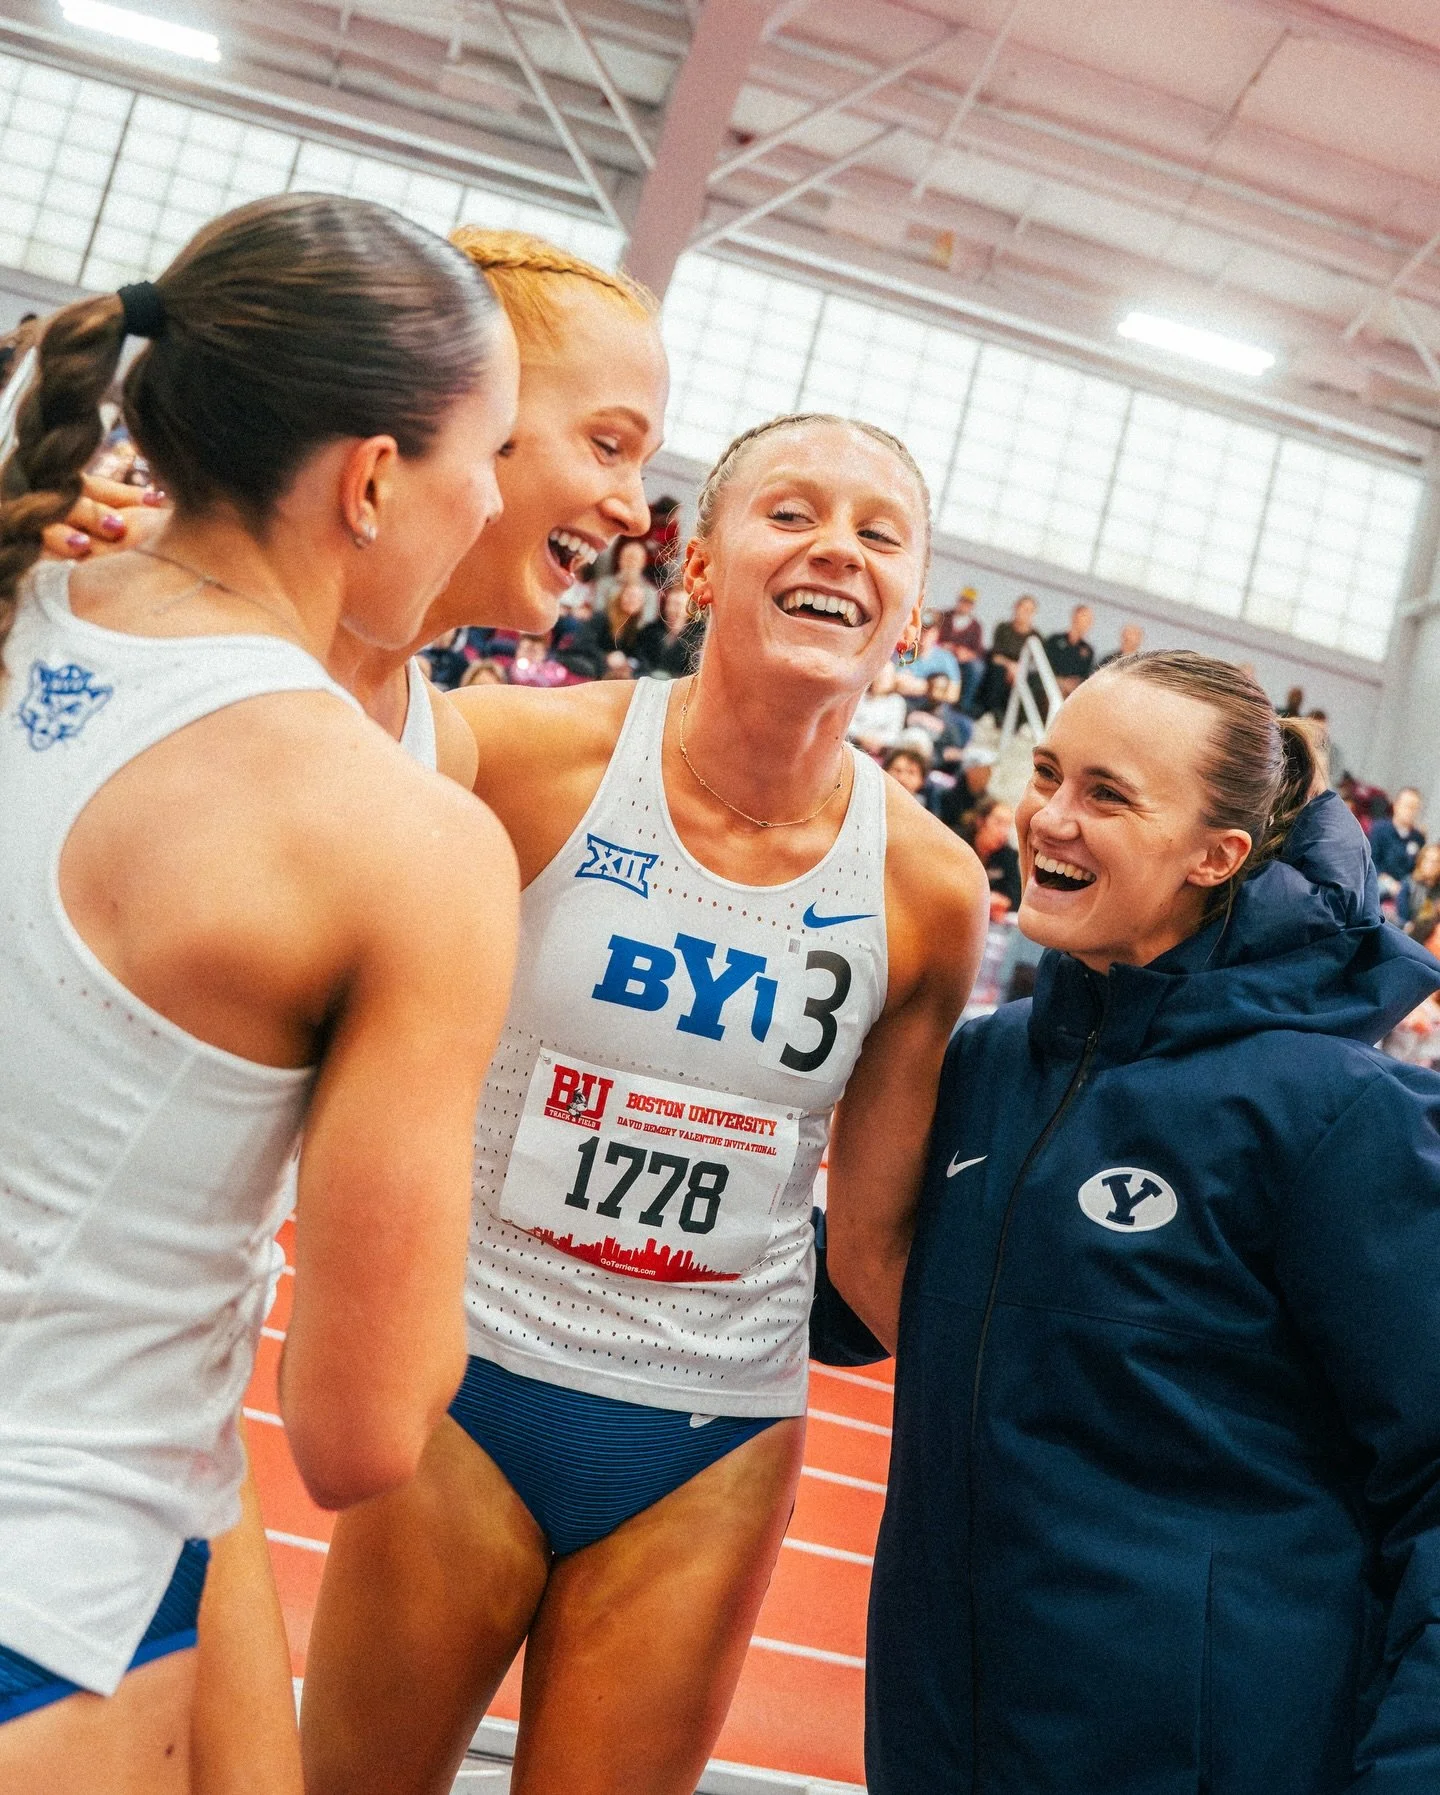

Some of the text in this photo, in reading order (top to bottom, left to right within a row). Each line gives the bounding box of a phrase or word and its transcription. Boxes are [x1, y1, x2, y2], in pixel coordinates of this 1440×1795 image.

[779, 949, 852, 1072] 3
[546, 1064, 614, 1120] BU
[626, 1092, 778, 1136] BOSTON UNIVERSITY
[549, 1109, 571, 1120] TRACK
[578, 1118, 596, 1128] FIELD
[616, 1116, 777, 1156] DAVID HEMERY VALENTINE INVITATIONAL
[564, 1135, 730, 1235] 1778
[1101, 1173, 1163, 1226] Y
[600, 1257, 656, 1276] GoTerriers.com
